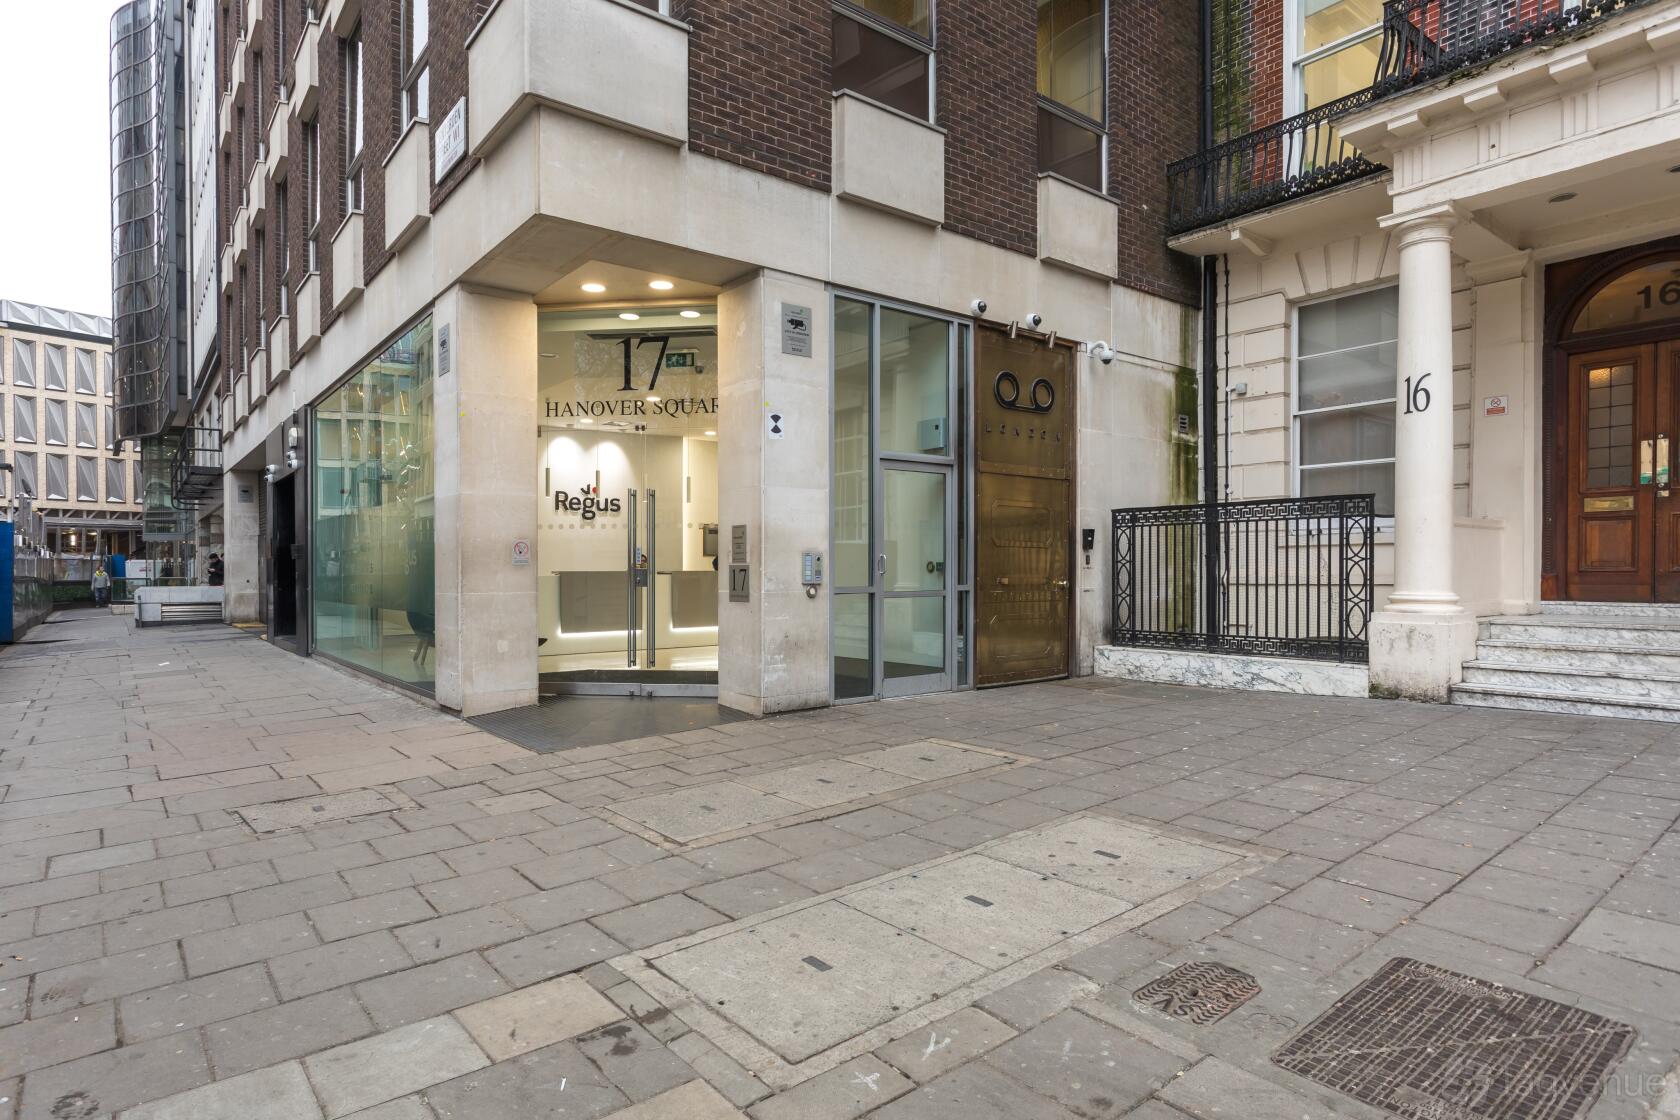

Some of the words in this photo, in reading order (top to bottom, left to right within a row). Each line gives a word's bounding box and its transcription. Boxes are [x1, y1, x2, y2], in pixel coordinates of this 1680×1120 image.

[1636, 281, 1680, 309] 16
[616, 336, 670, 391] 17
[1403, 372, 1432, 415] 16
[545, 399, 647, 418] HANOVER
[554, 490, 622, 521] Regus
[732, 568, 747, 591] 17
